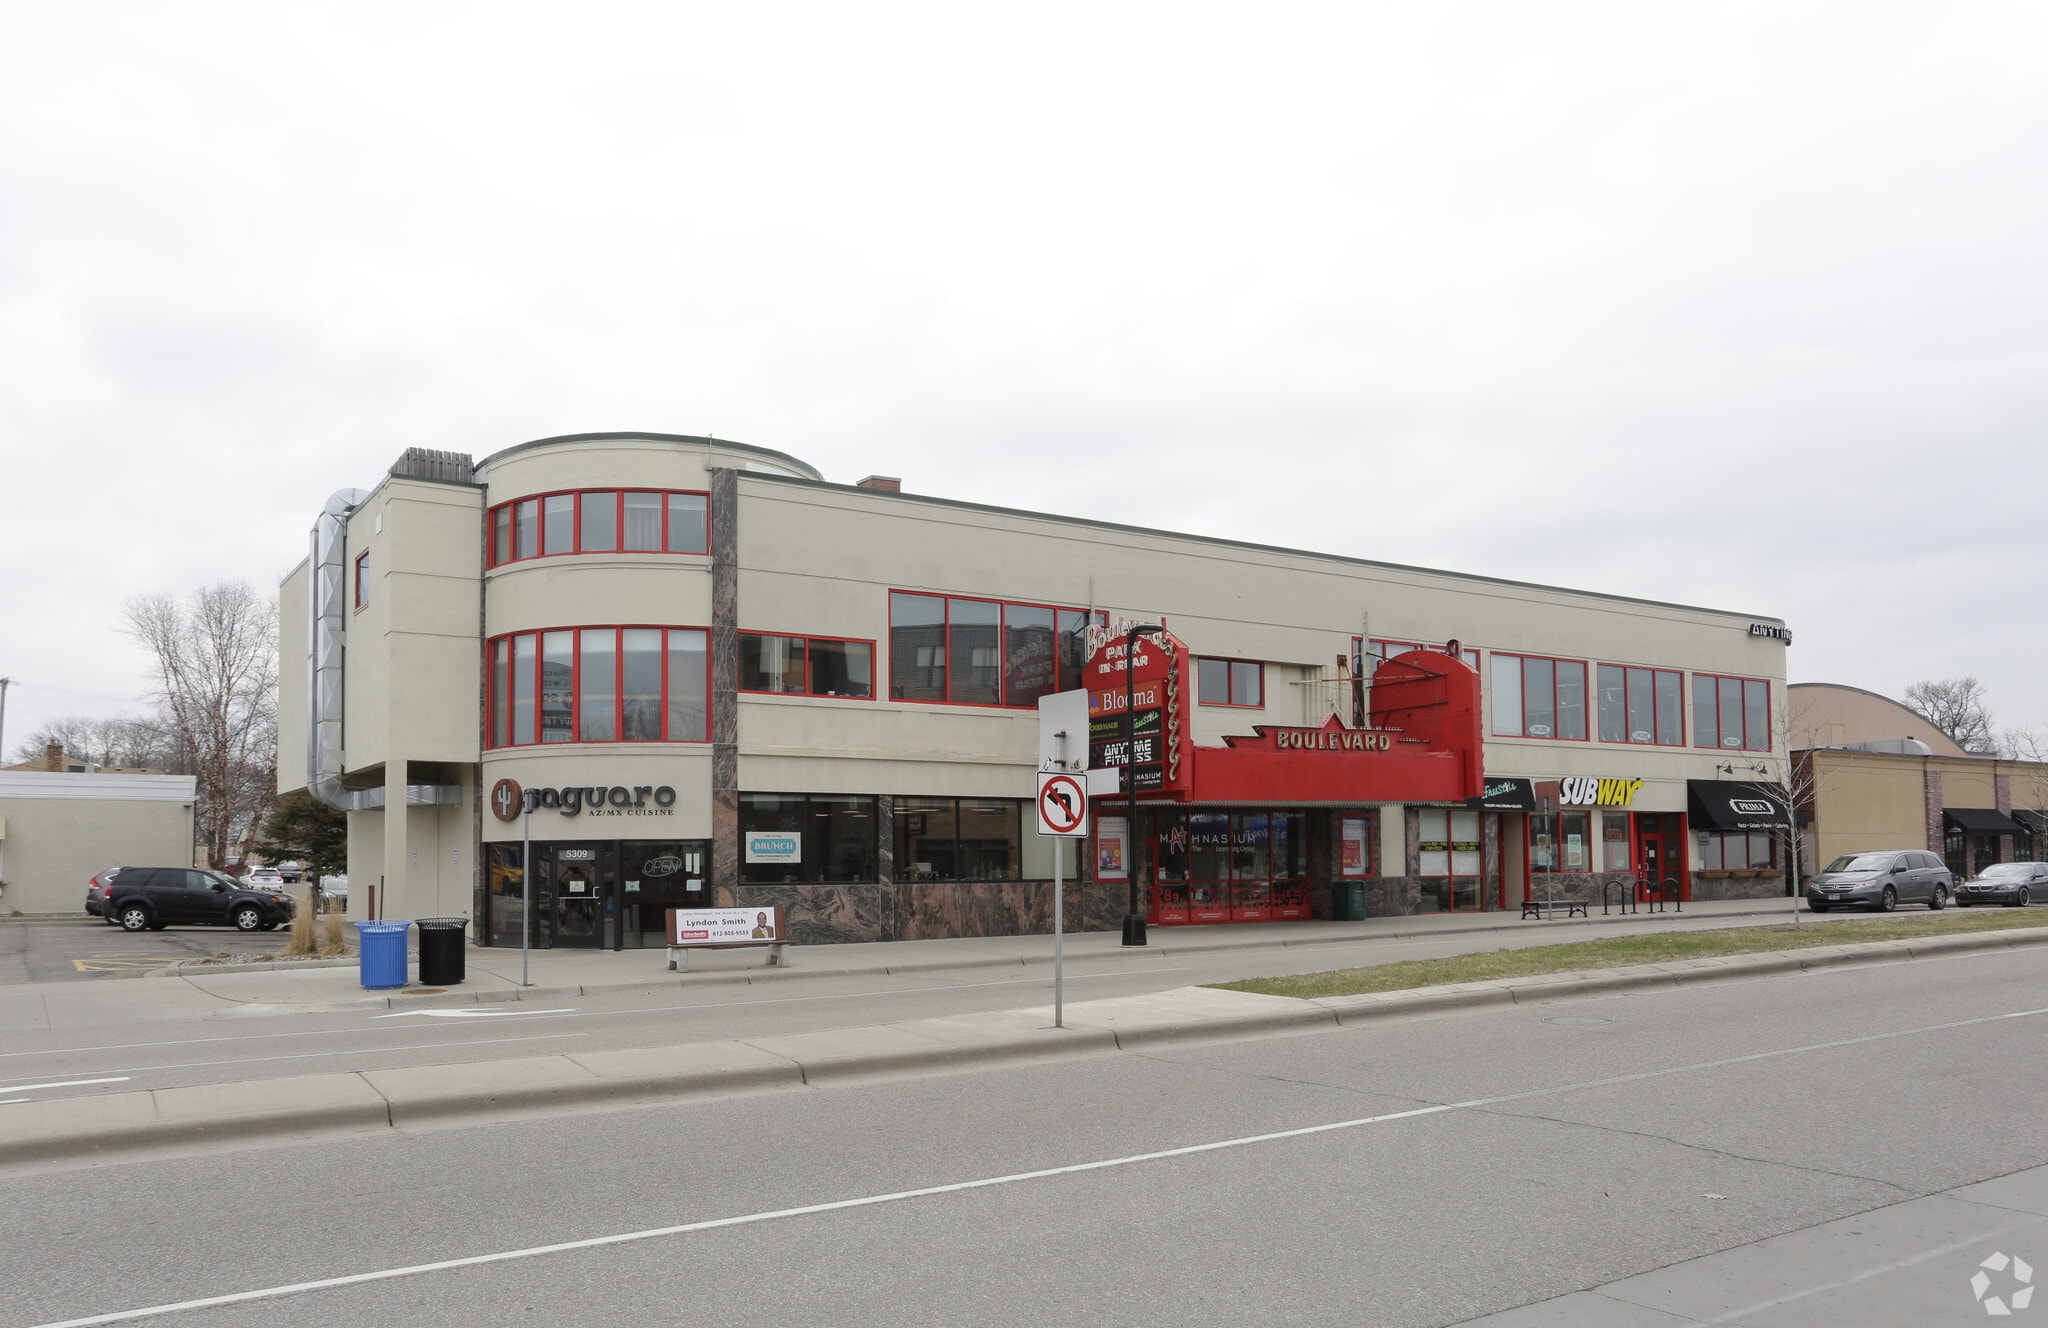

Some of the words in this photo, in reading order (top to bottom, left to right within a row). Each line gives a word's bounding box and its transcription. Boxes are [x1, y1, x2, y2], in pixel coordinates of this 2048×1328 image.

[1104, 739, 1152, 756] ANYME
[1277, 731, 1391, 751] BOULEVARD
[1105, 752, 1152, 766] FITNSS
[1559, 777, 1644, 806] SUBWAY
[1738, 803, 1767, 811] PRIMA
[755, 842, 793, 850] BRUNCH
[566, 850, 588, 858] 5309
[643, 860, 680, 874] OPEN
[686, 919, 718, 927] Lyndon
